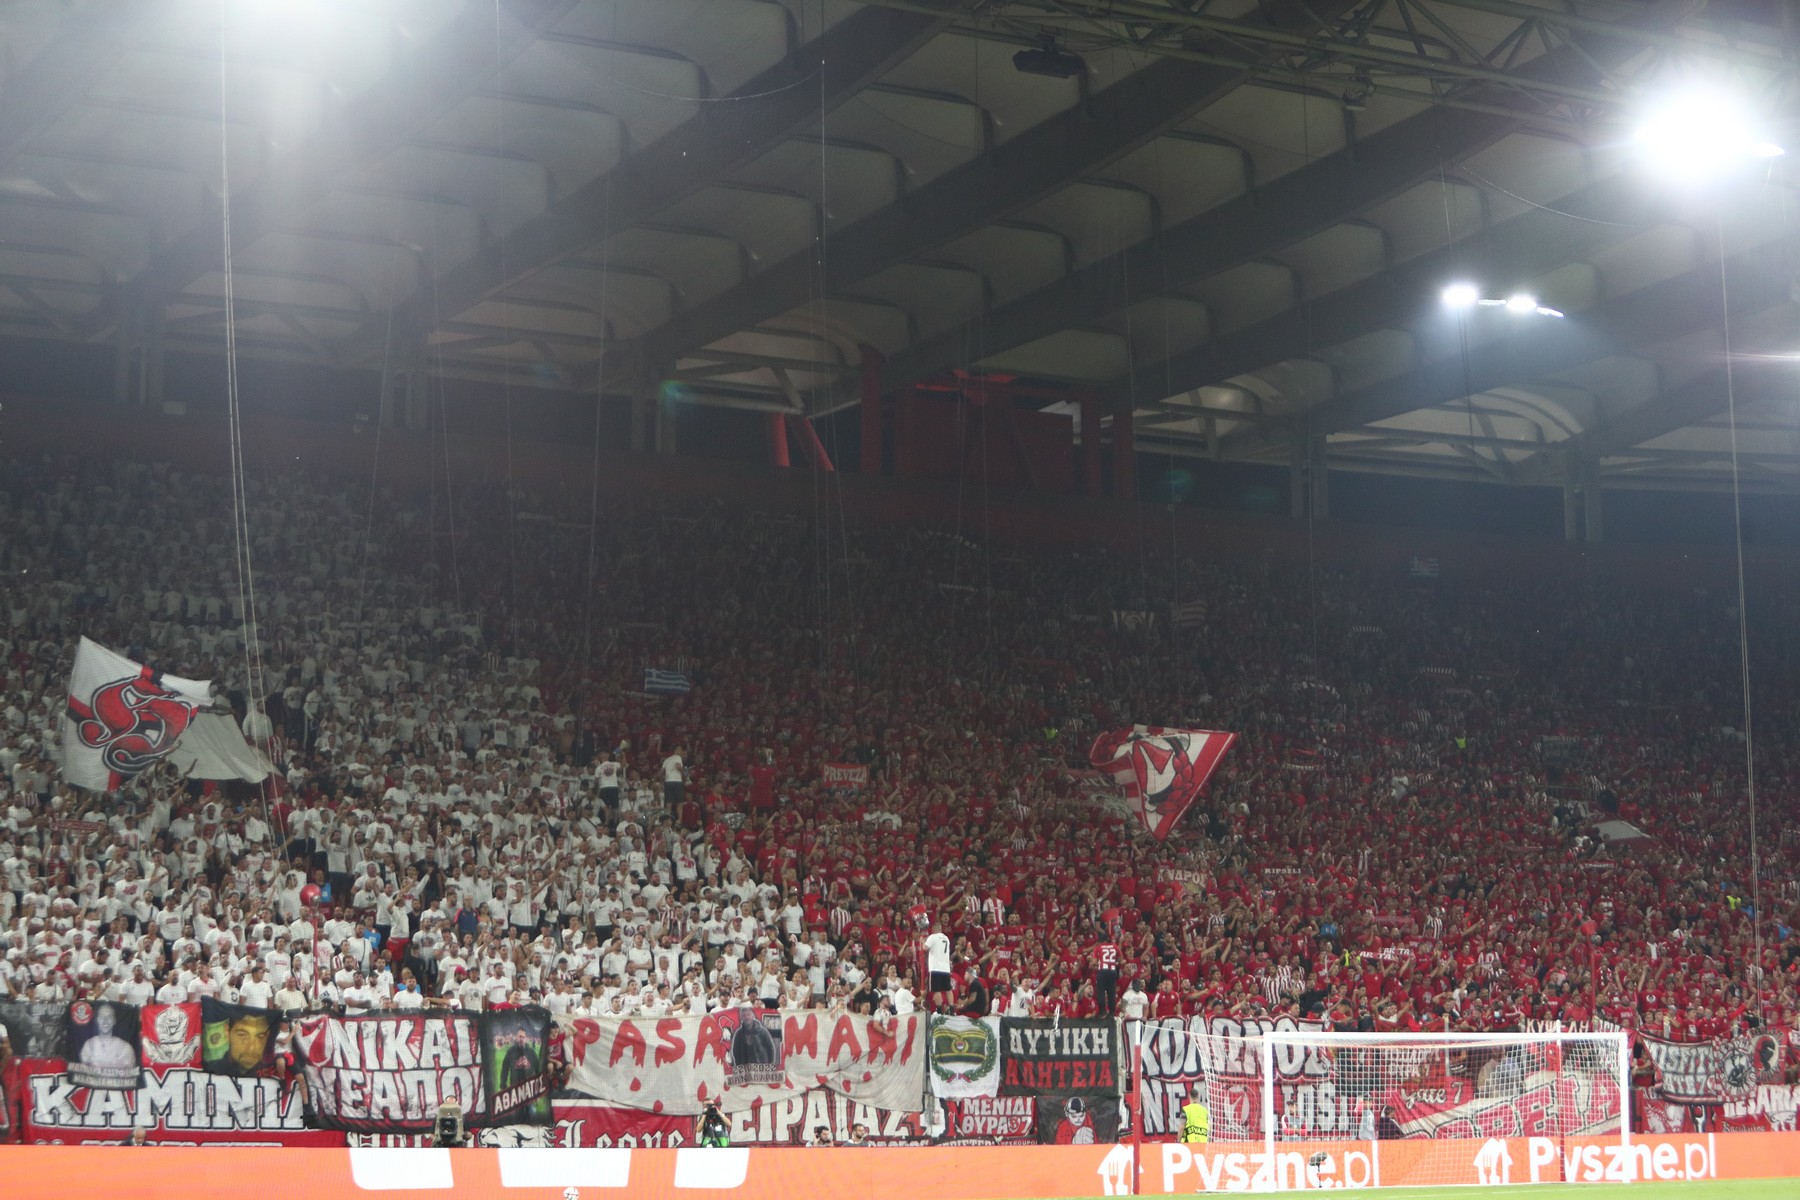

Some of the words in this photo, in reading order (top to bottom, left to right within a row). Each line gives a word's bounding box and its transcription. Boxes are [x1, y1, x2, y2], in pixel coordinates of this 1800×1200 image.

[823, 764, 868, 784] PREVEZA
[1264, 867, 1301, 875] KIPSELI
[941, 939, 949, 954] 7
[1101, 948, 1117, 963] 22
[1009, 1027, 1110, 1056] ΔΥΤΙΚΗ
[1452, 1081, 1464, 1104] 7
[963, 1096, 1034, 1116] ΜΕΝΙΔΙ
[961, 1115, 1008, 1135] ΘΥΡΑ
[1020, 1116, 1034, 1134] 7
[1528, 1132, 1717, 1183] Pyszne.pl
[1162, 1143, 1379, 1193] Pyszne.pl
